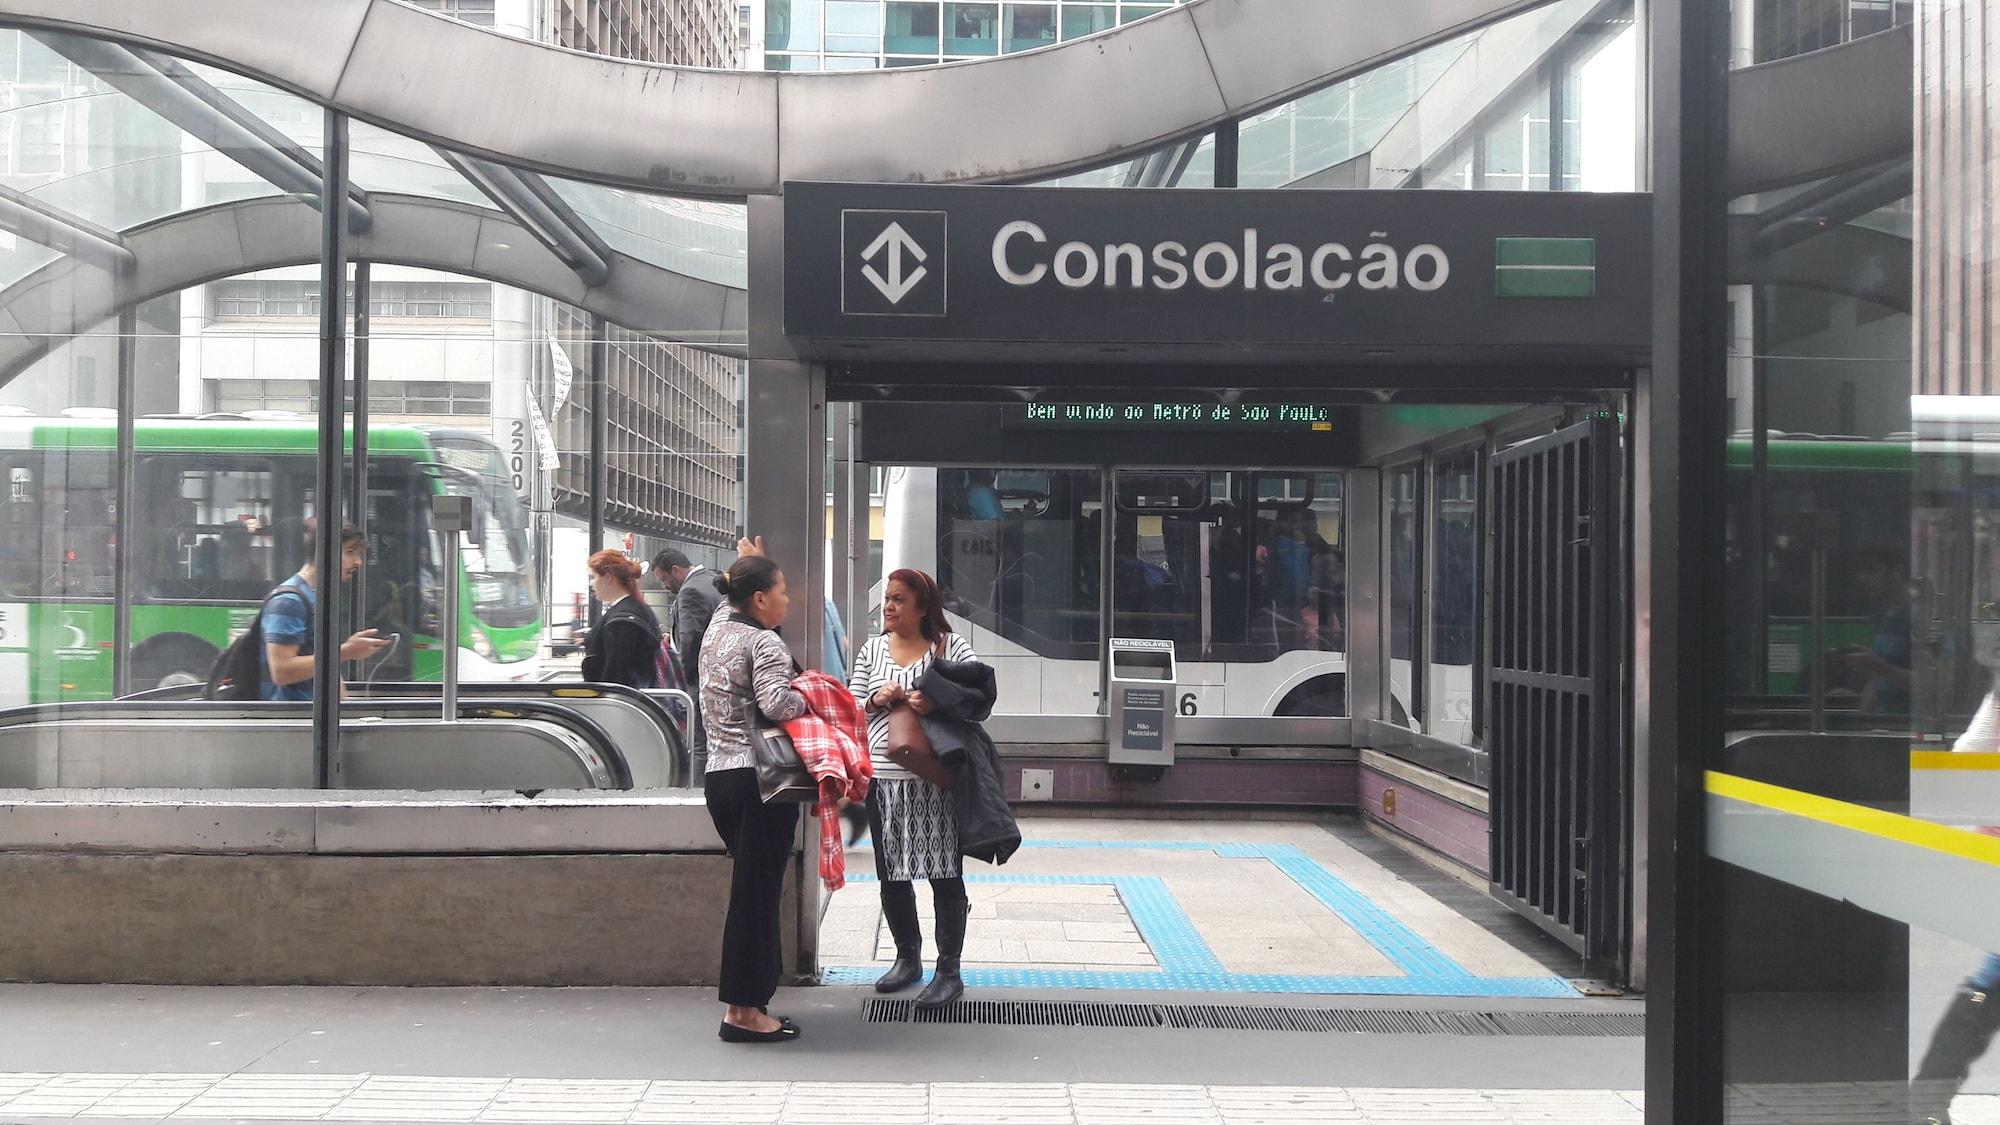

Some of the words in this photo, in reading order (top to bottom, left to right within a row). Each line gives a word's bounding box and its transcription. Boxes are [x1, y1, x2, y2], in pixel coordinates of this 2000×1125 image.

[992, 220, 1450, 301] Consolação
[1124, 405, 1144, 421] ao
[1212, 403, 1232, 421] de
[511, 420, 524, 491] 2200
[1136, 722, 1150, 730] Não
